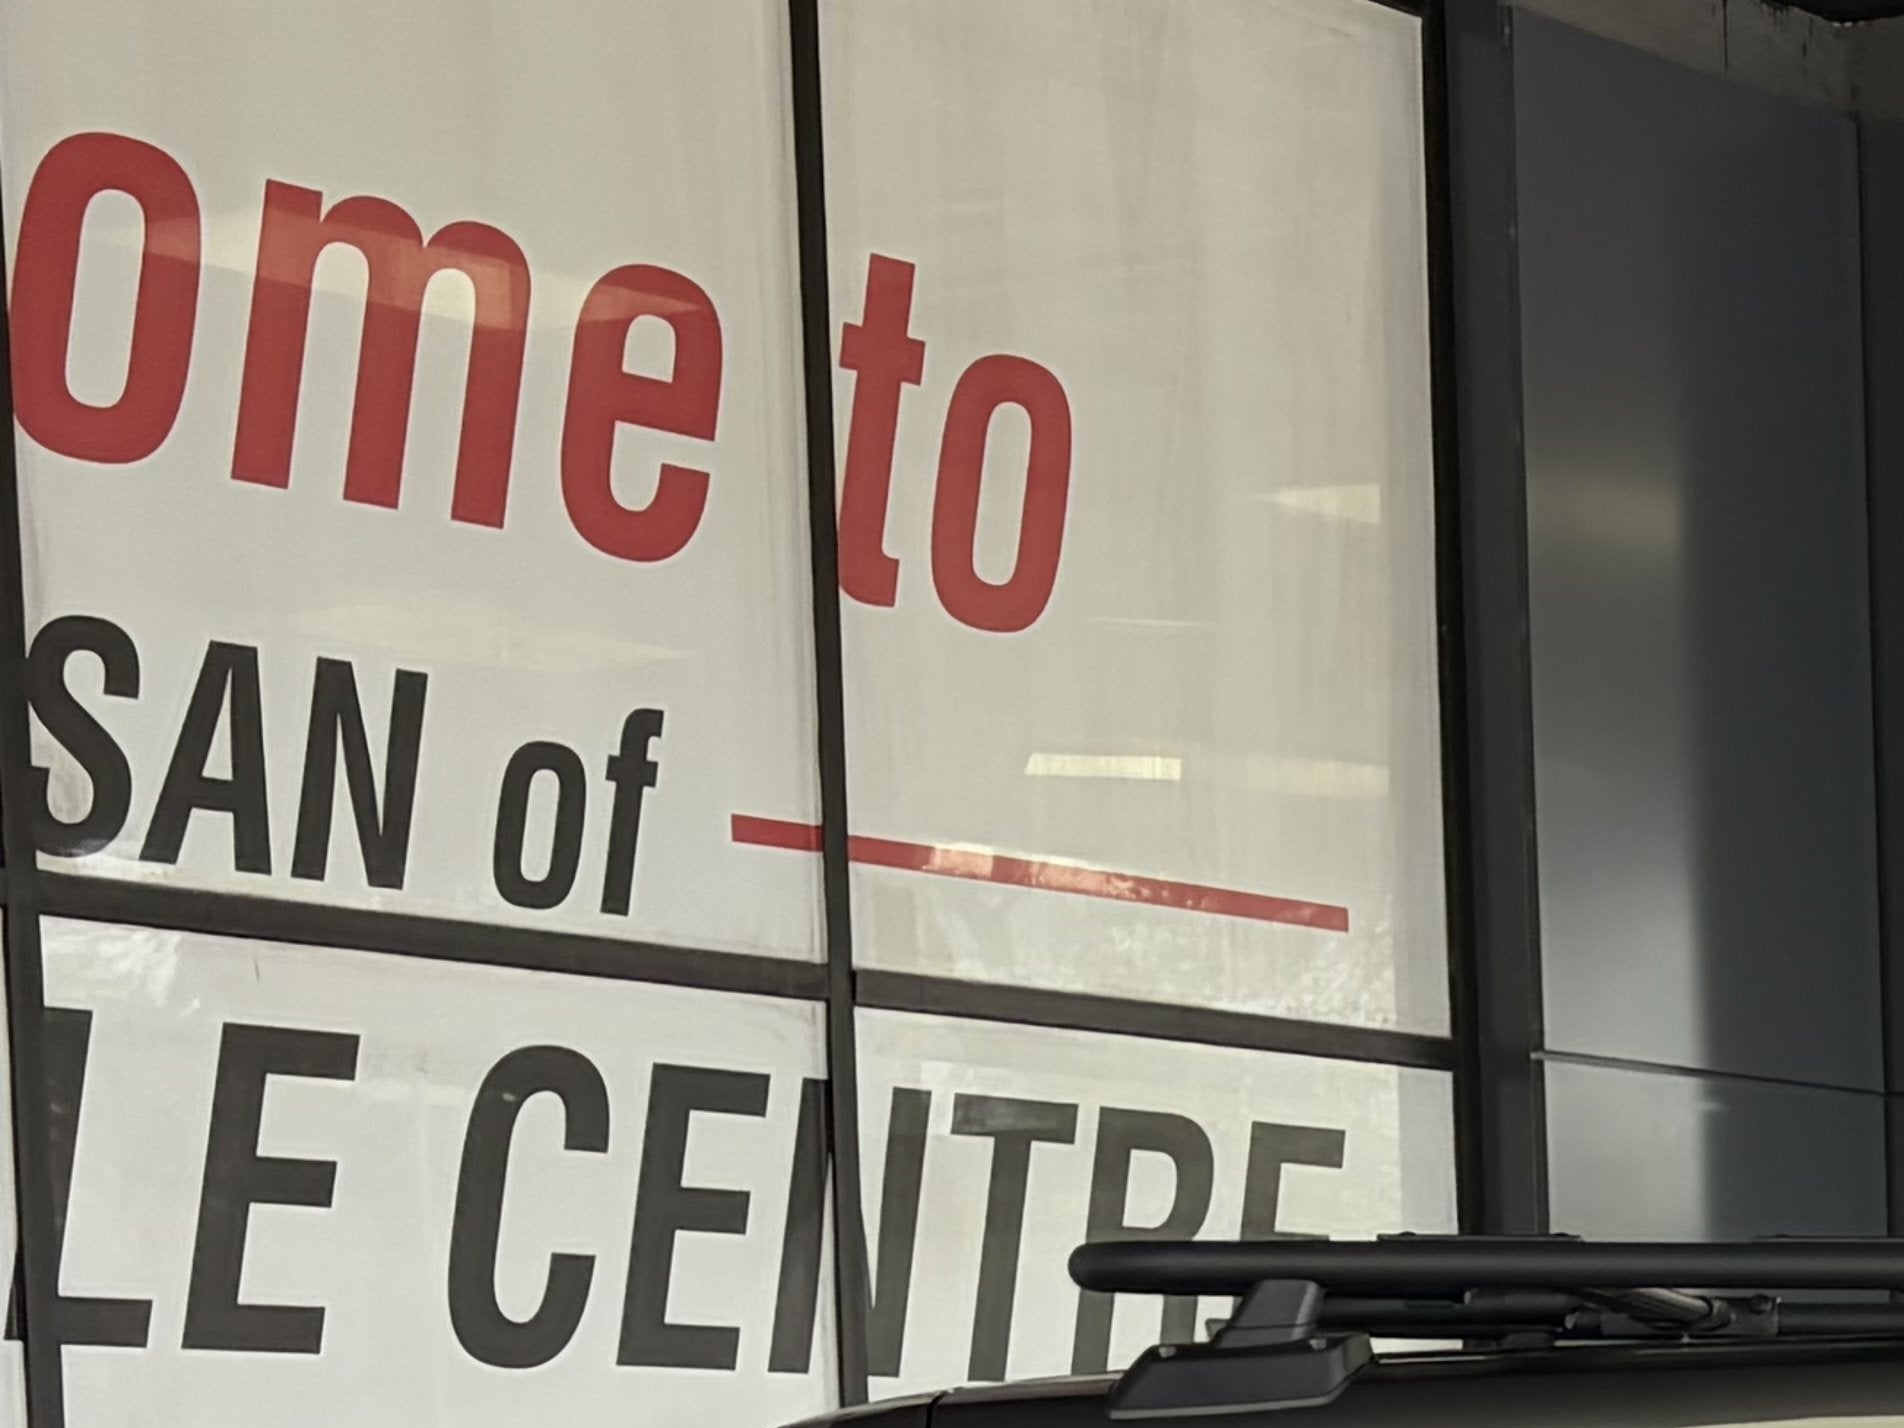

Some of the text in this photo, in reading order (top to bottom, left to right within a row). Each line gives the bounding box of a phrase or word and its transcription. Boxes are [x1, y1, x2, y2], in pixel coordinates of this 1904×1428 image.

[8, 130, 1073, 633] ome to
[24, 614, 664, 916] SAN of
